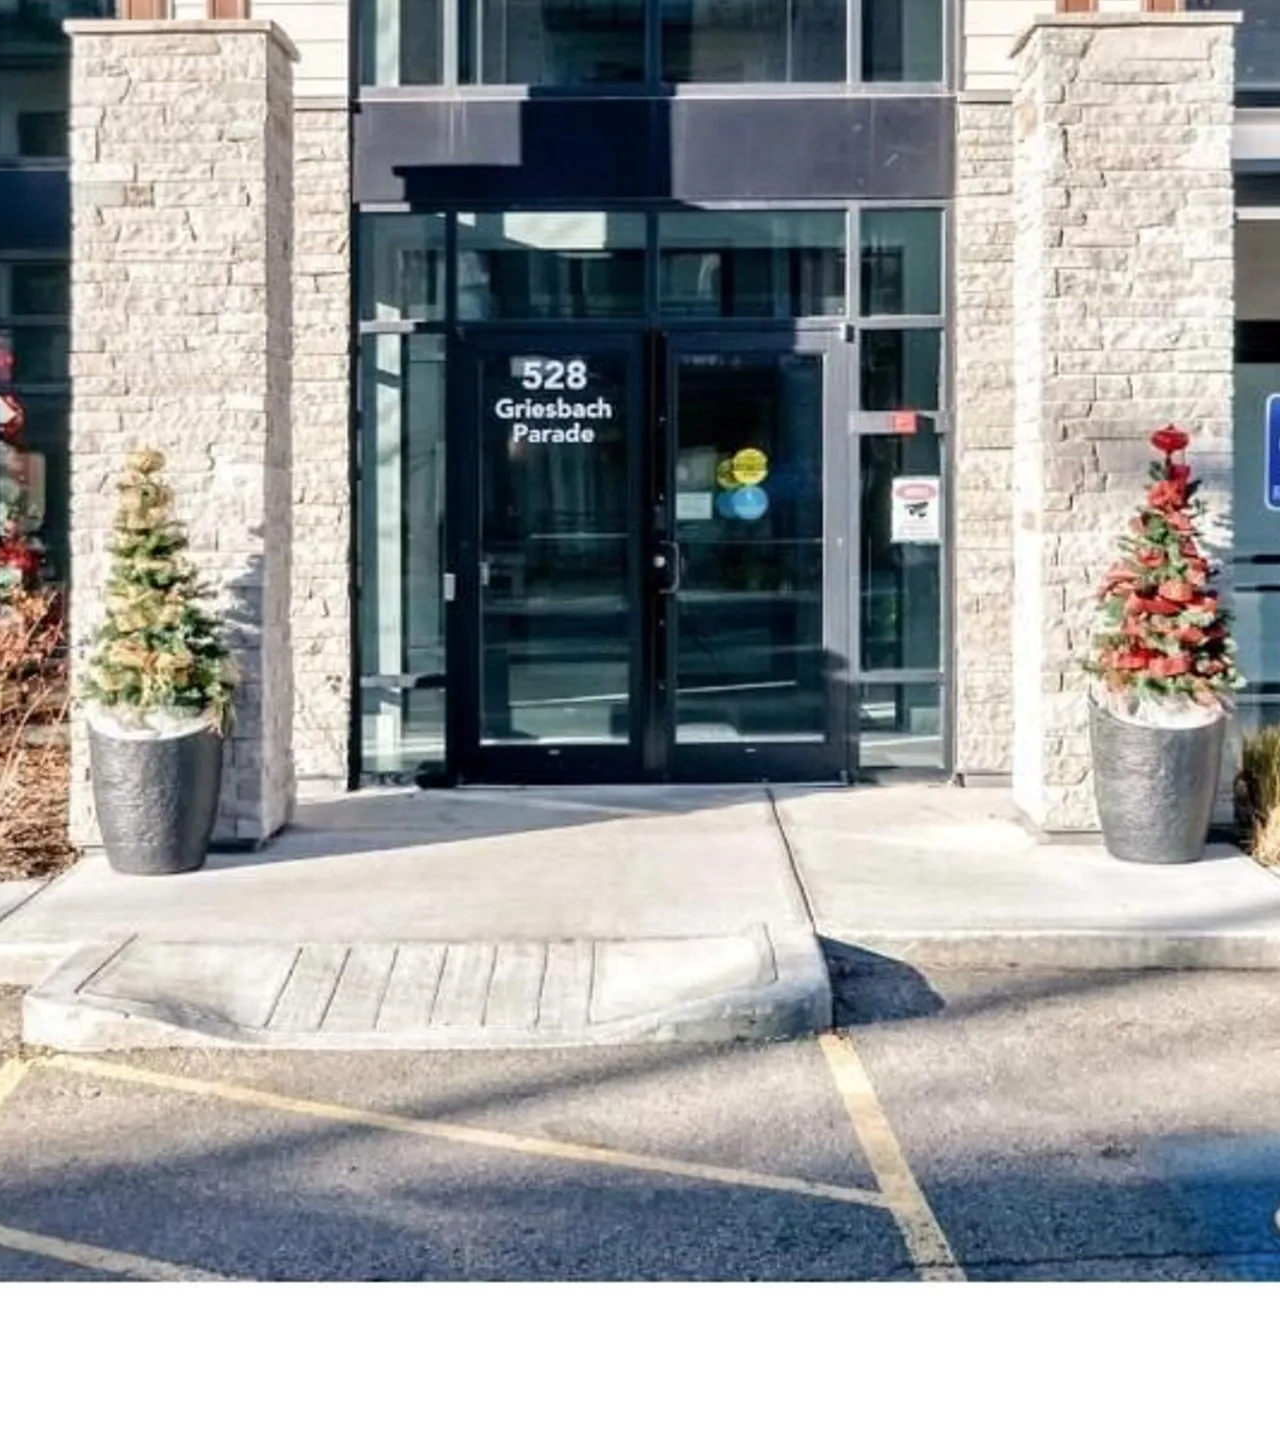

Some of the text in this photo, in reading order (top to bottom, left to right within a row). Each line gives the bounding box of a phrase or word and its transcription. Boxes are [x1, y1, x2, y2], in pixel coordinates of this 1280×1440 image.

[522, 360, 587, 390] 528
[495, 397, 613, 419] Griesbach
[512, 422, 595, 443] Parade
